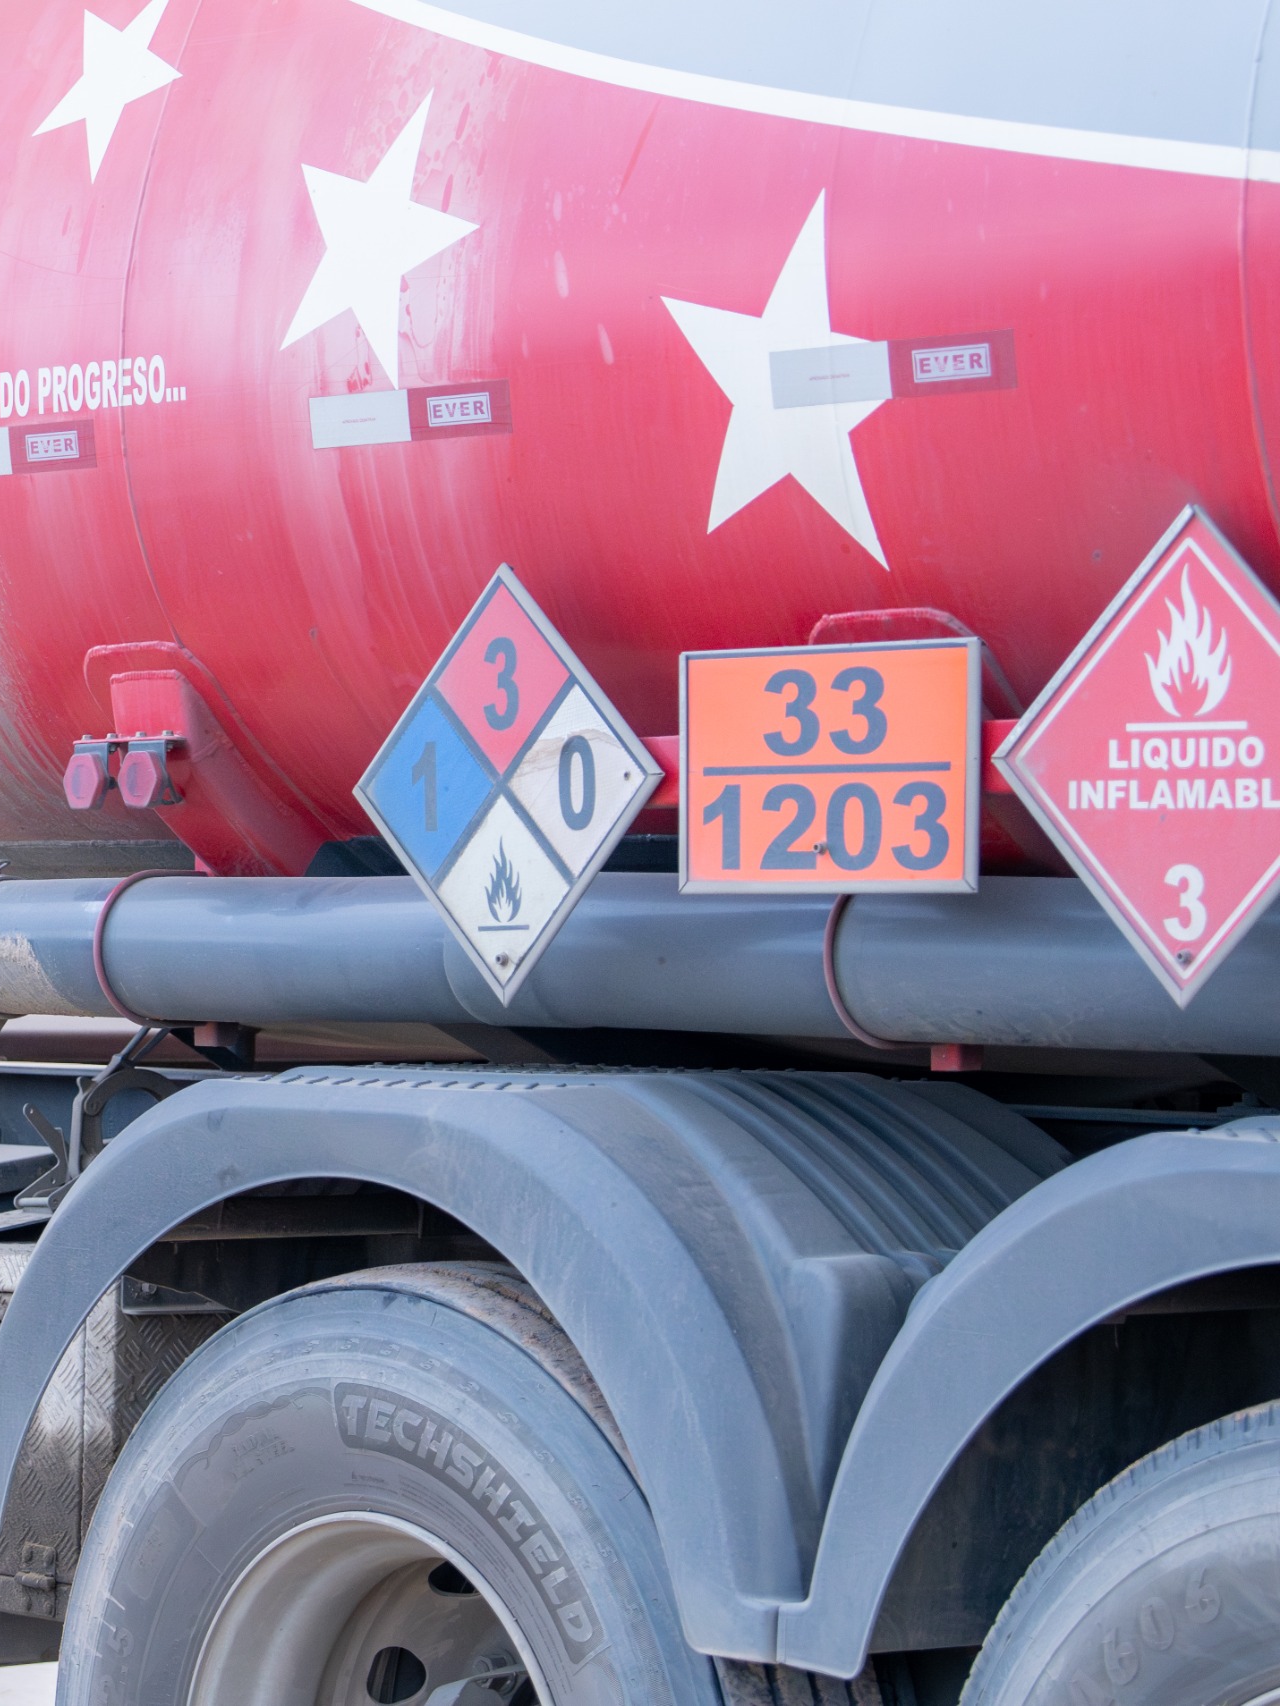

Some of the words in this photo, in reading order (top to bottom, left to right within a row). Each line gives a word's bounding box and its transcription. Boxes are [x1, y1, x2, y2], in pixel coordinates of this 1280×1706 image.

[38, 355, 187, 415] PROGRESO...
[918, 352, 984, 374] EVER
[29, 437, 74, 455] EVER
[432, 400, 486, 419] EVER
[483, 637, 519, 731] 3
[762, 666, 888, 756] 33
[411, 741, 438, 832] 1
[558, 735, 596, 831] 0
[1108, 736, 1265, 771] LIQUIDO
[702, 780, 950, 871] 1203
[1163, 863, 1208, 942] 3
[341, 1394, 594, 1643] TECHSHIELD
